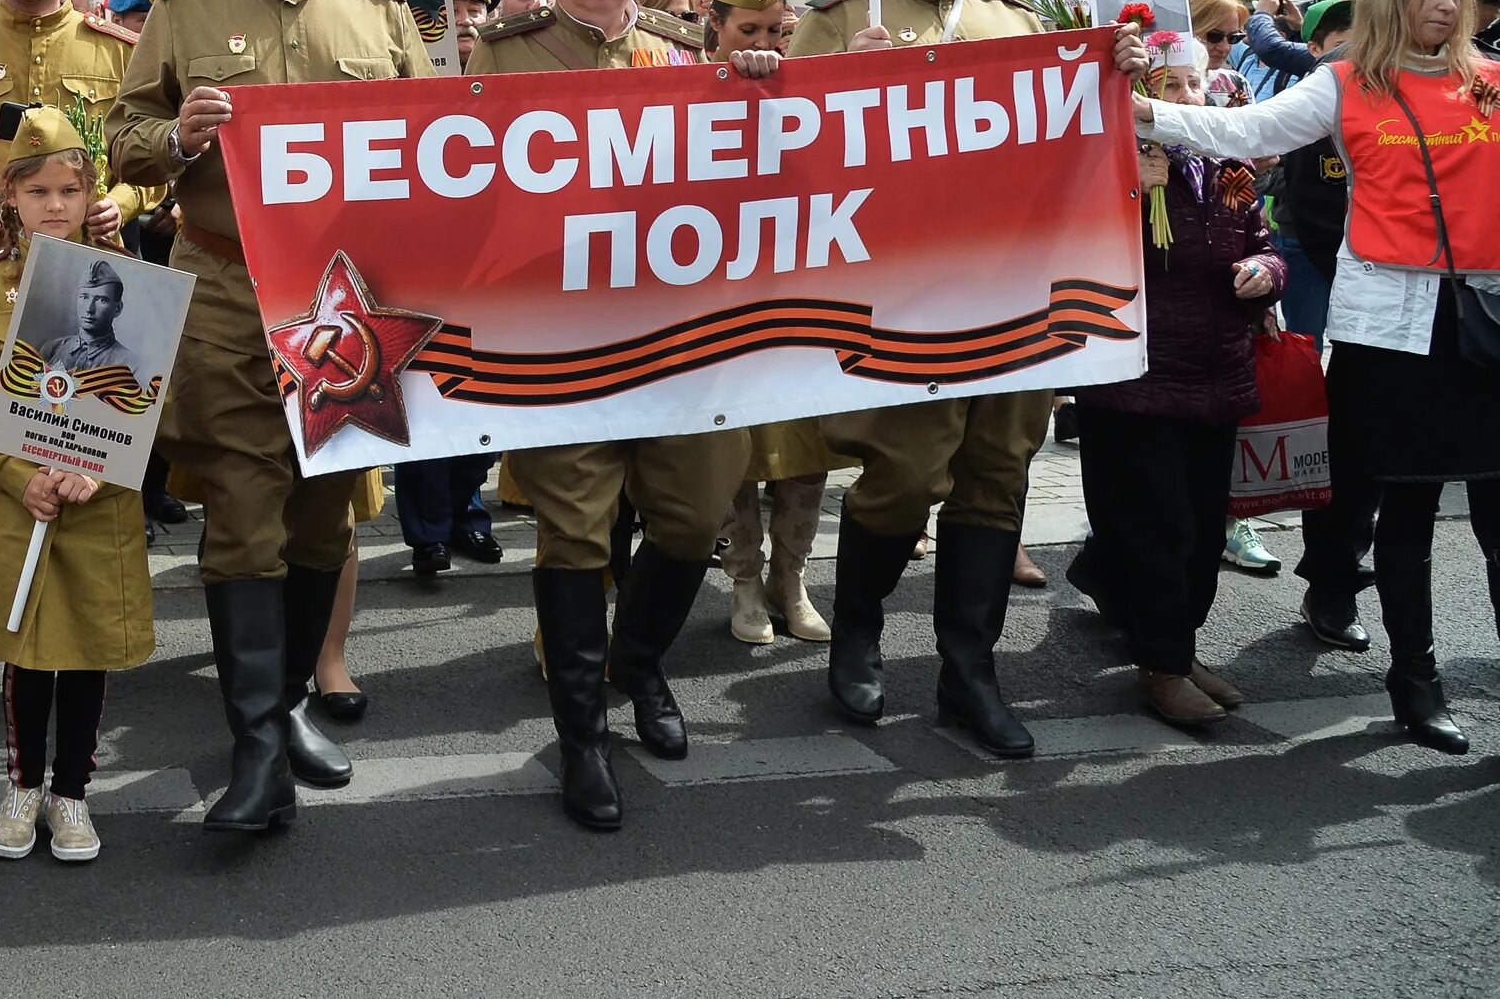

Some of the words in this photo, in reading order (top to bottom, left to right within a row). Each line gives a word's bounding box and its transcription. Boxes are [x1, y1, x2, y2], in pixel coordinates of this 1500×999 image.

[259, 42, 1106, 206] БЕССМЕРТНЫЙ
[561, 187, 875, 292] ПОЛК
[8, 400, 70, 430] Василий
[71, 417, 134, 446] Симонов
[25, 430, 48, 443] ПОГИБ
[48, 436, 65, 449] ПОД
[64, 440, 108, 460] ХАРЬКОВОМ
[21, 443, 82, 468] БЕССМЕРТНЫЙ
[81, 458, 105, 473] ПОЛК
[1236, 434, 1293, 484] M
[1293, 450, 1328, 470] MODE
